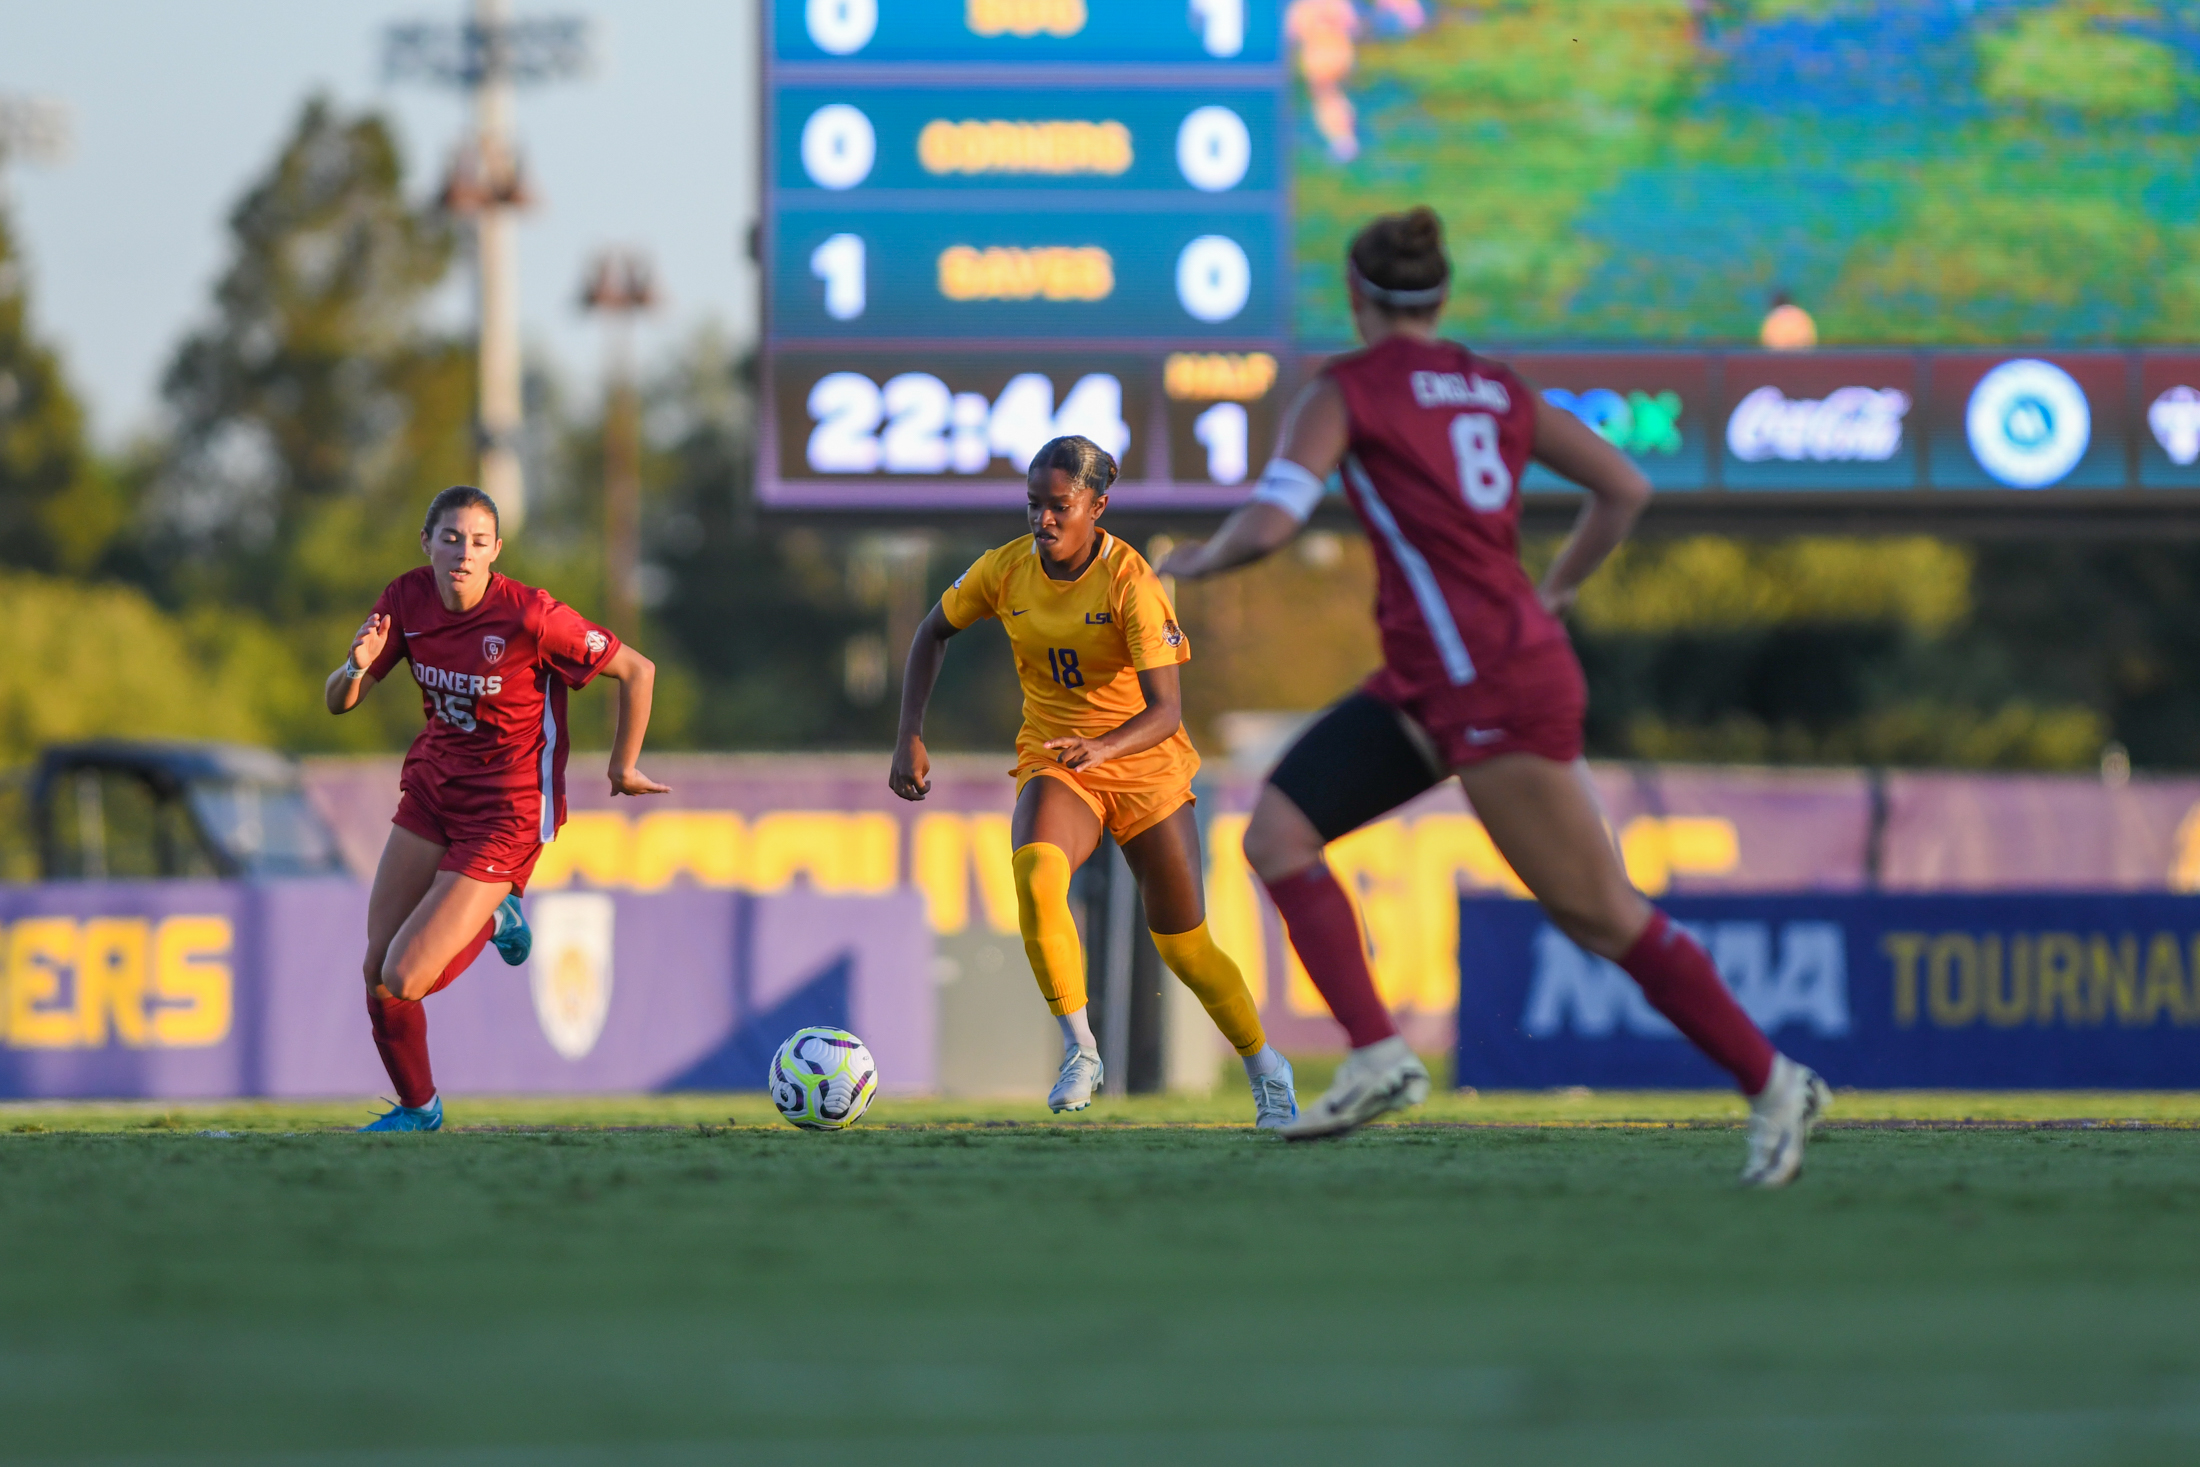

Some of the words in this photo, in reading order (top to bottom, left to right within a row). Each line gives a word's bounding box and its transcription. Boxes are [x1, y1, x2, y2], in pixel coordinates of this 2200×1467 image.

[801, 103, 877, 190] 0
[917, 119, 1133, 176] CORNERS
[1175, 105, 1251, 192] 0
[810, 232, 867, 321] 1
[937, 245, 1115, 301] SAVES
[1175, 234, 1251, 323] 0
[1163, 351, 1278, 401] HALF
[806, 371, 1131, 475] 22:44
[1194, 401, 1249, 486] 1
[1449, 412, 1513, 514] 8
[413, 659, 503, 696] OONERS
[426, 688, 477, 733] 15
[1048, 647, 1086, 690] 18
[1884, 930, 2200, 1028] TOURNA
